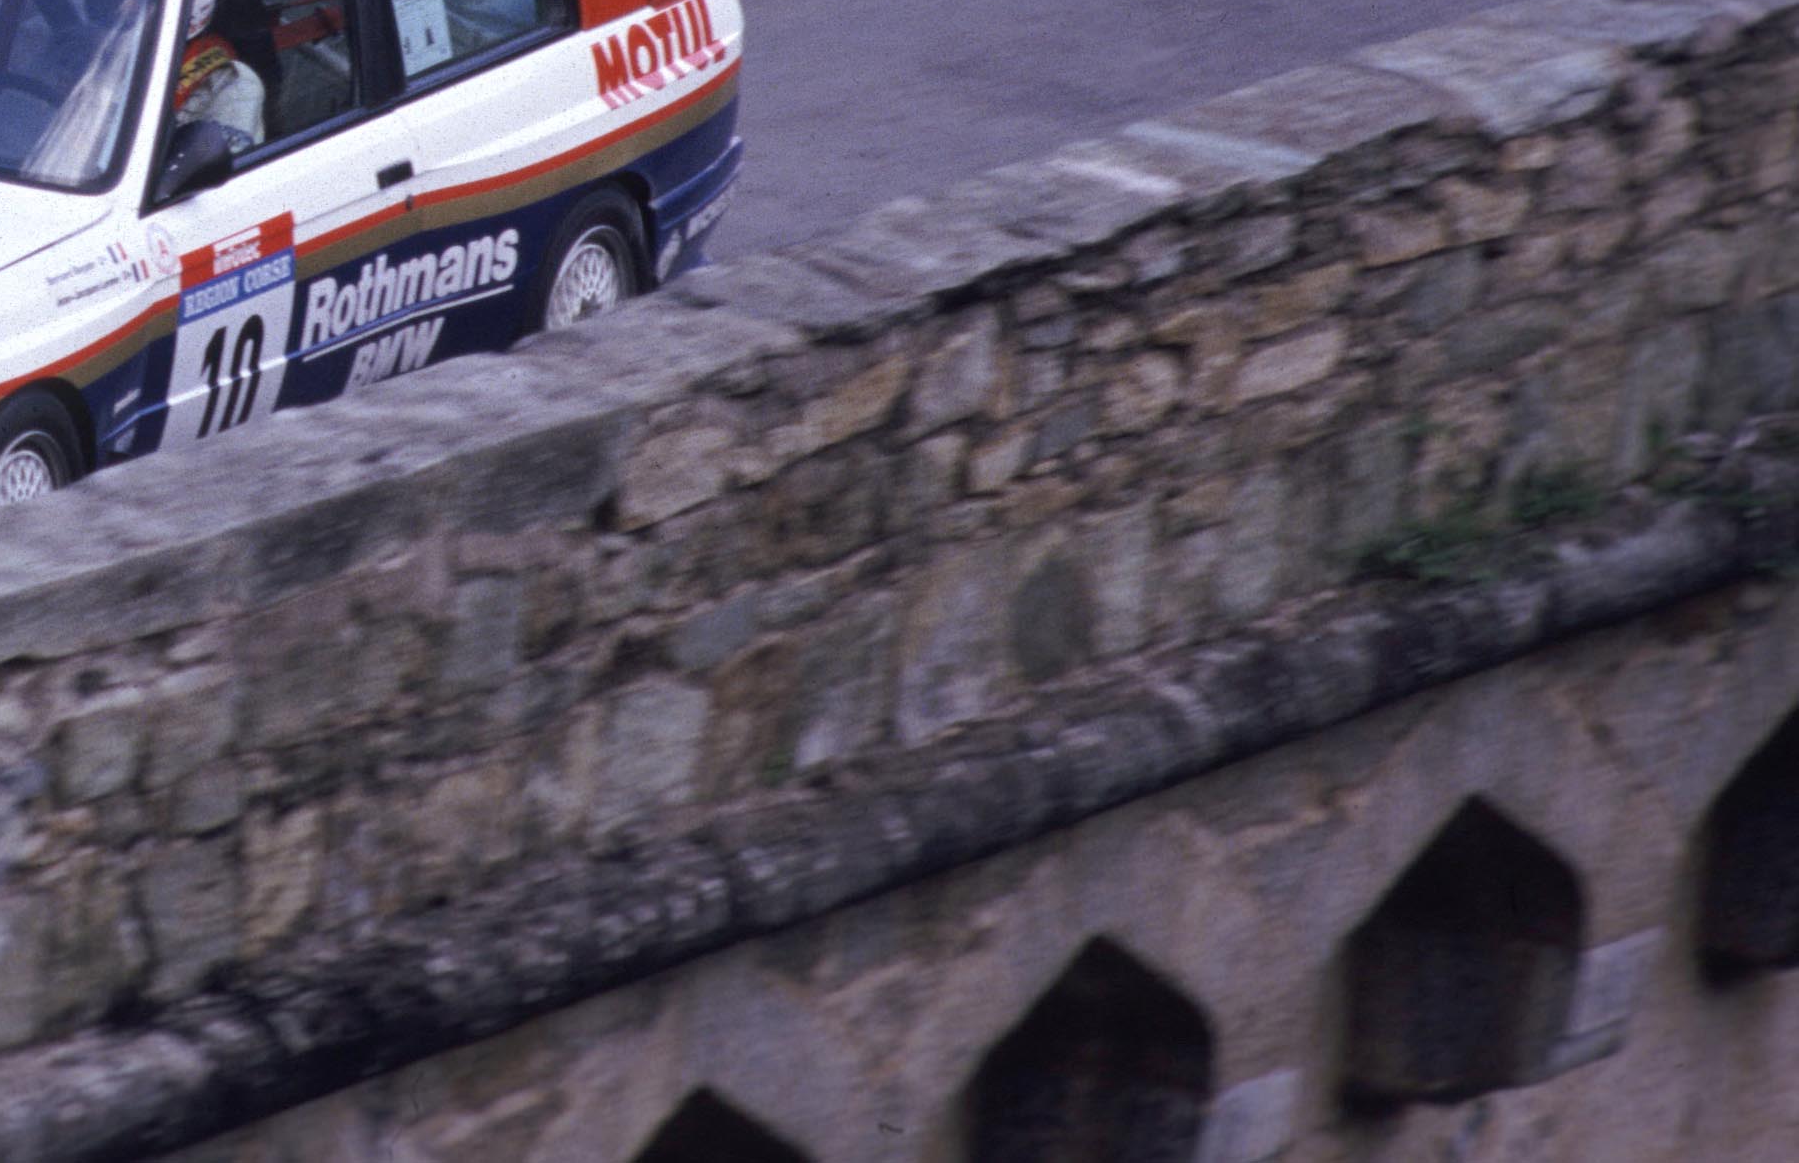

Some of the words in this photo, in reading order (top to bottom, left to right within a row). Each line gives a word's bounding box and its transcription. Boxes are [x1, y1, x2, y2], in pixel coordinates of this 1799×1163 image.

[299, 228, 520, 353] Rothmans
[347, 317, 445, 387] BMW
[196, 314, 264, 439] 10
